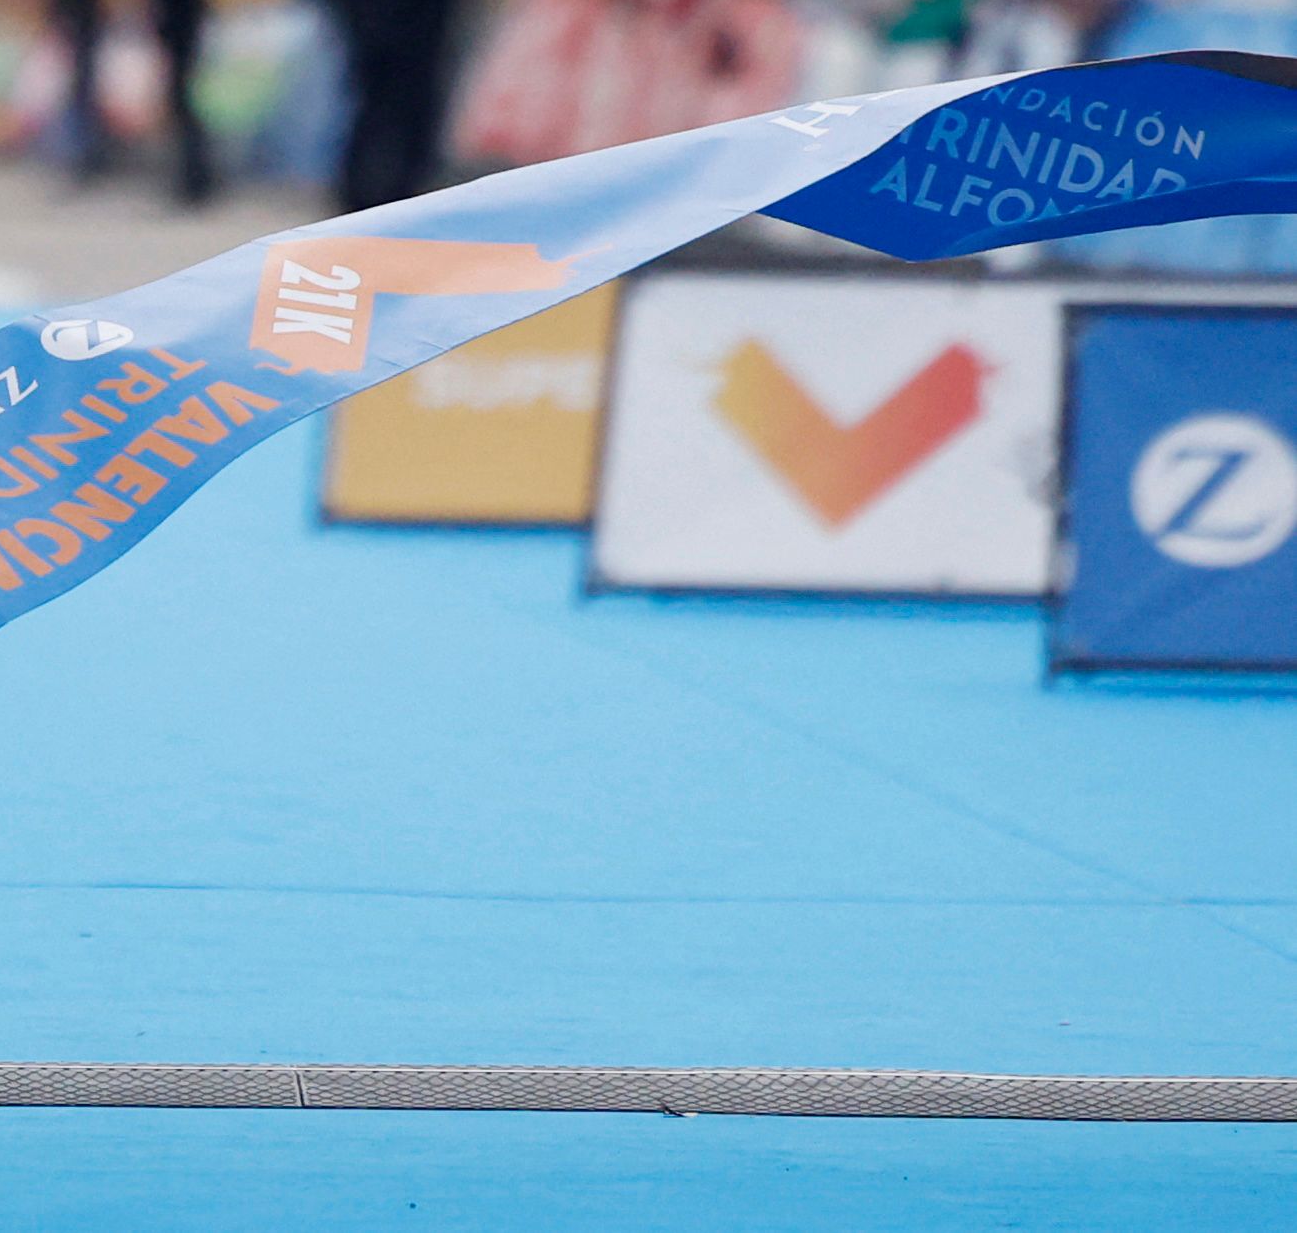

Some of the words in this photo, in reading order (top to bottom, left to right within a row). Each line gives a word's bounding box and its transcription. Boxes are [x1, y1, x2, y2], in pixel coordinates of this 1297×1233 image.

[980, 85, 1206, 160] NDACIÓN
[869, 156, 1090, 229] ALFO
[271, 258, 362, 346] 21K
